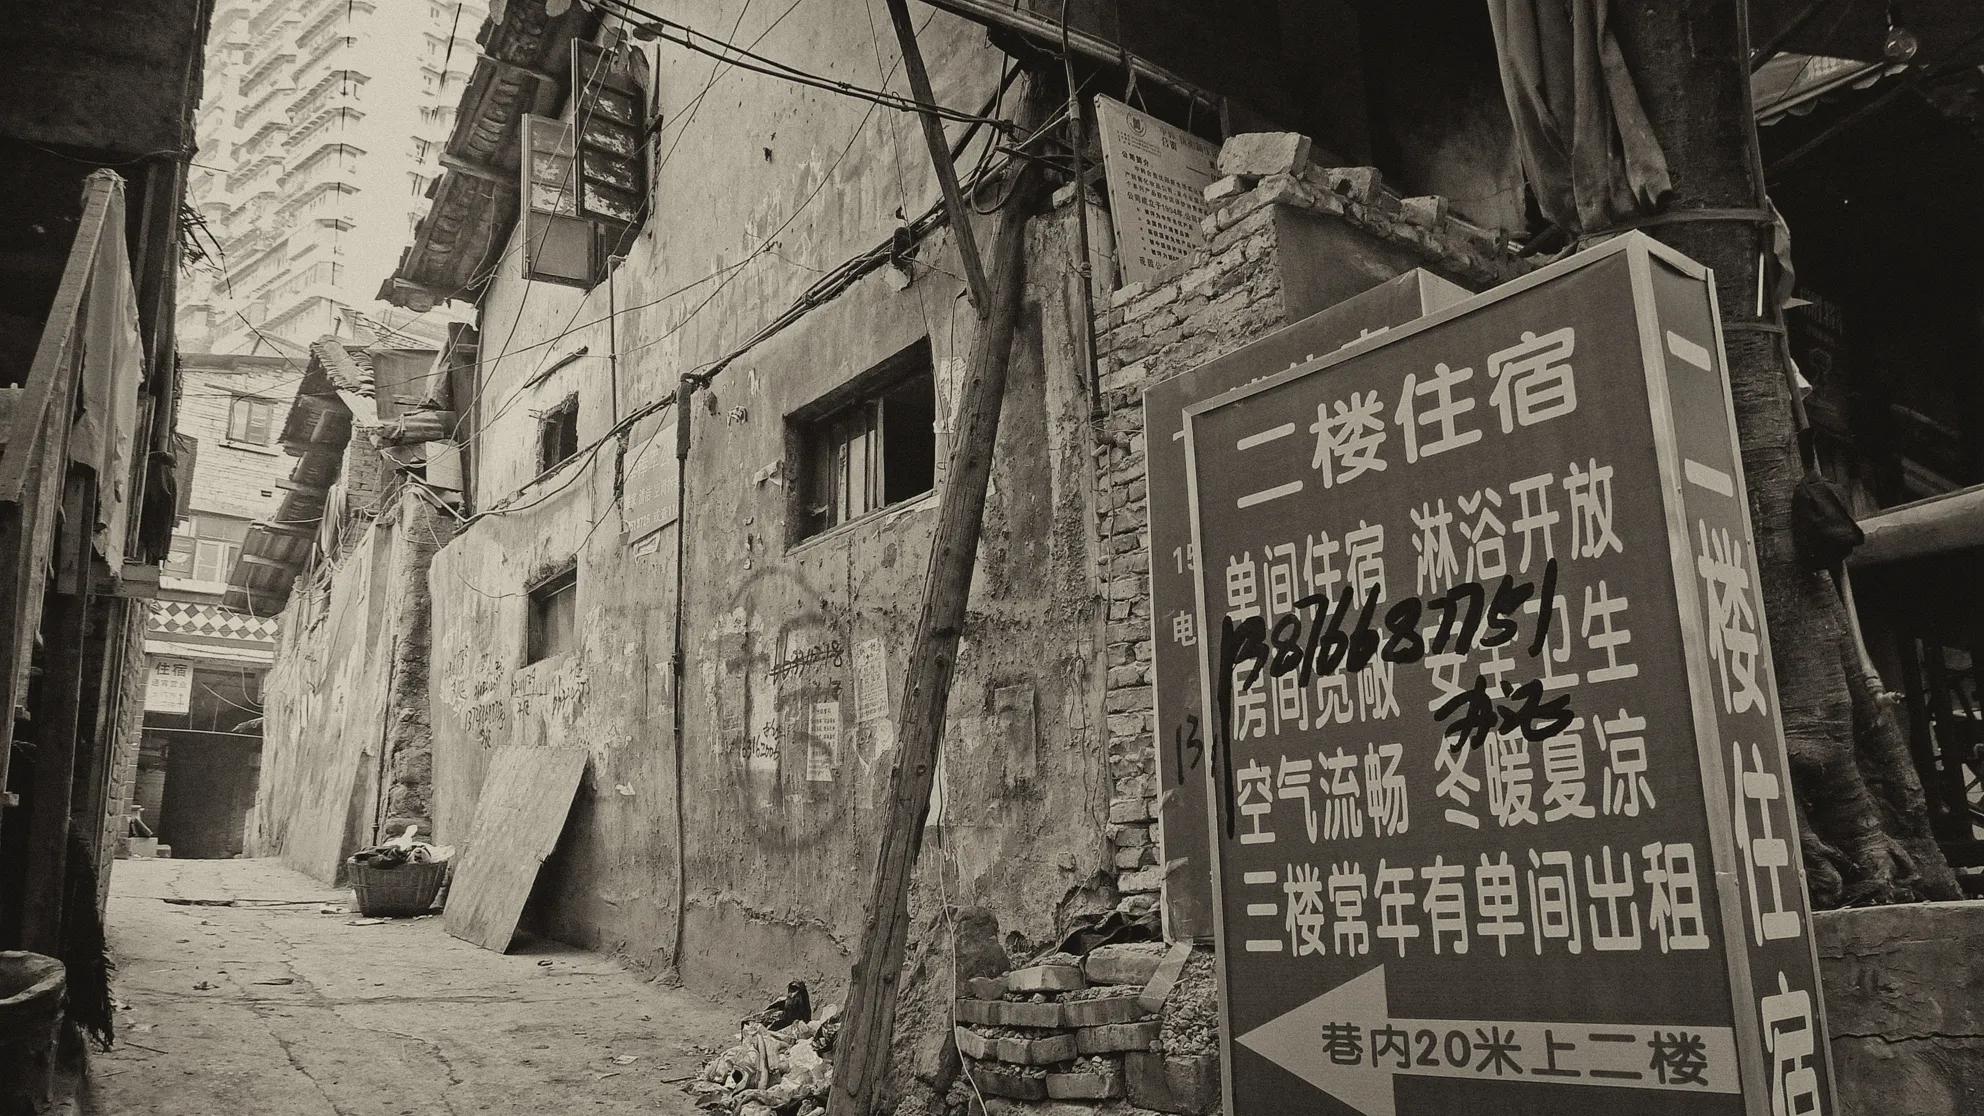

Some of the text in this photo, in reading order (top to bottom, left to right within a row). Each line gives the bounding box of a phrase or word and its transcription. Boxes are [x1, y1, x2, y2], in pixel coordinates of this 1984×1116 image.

[1237, 327, 1575, 508] 二楼住宿
[1226, 457, 1624, 630] 单间住宿 淋浴开放
[155, 661, 188, 677] 住宿
[1172, 610, 1197, 647] 电
[1236, 709, 1656, 845] 空气流畅 冬暖夏凉
[1666, 330, 1820, 1116] 二楼住宿
[1242, 841, 1710, 958] 三楼常年有单间出租
[1321, 1021, 1709, 1087] 巷内20米上二楼
